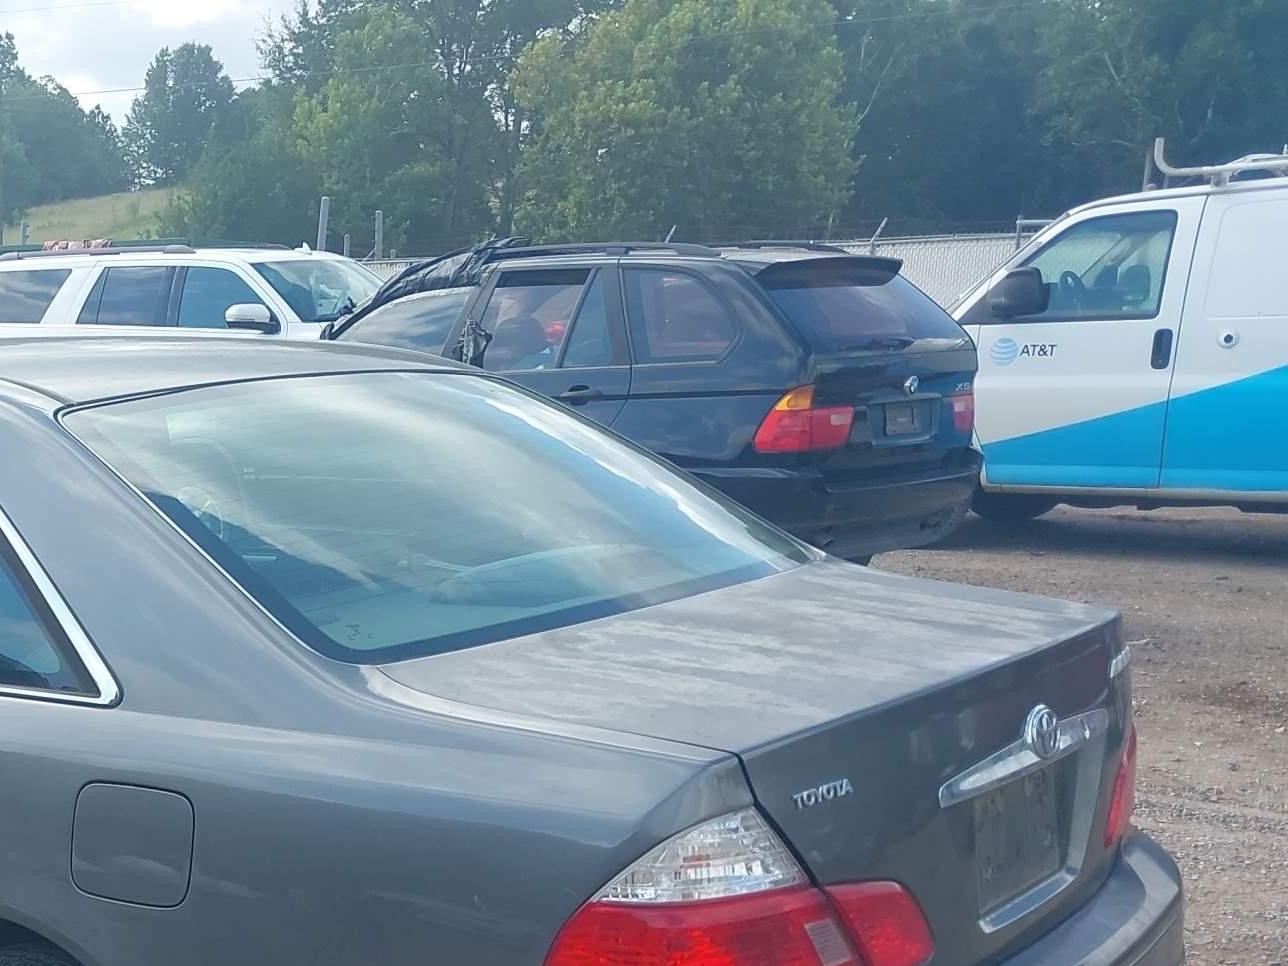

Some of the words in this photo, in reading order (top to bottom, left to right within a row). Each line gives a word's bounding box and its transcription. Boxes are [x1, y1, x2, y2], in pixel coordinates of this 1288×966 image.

[1019, 344, 1058, 357] AT&T
[954, 382, 970, 392] X5
[792, 778, 854, 809] TOYOTA
